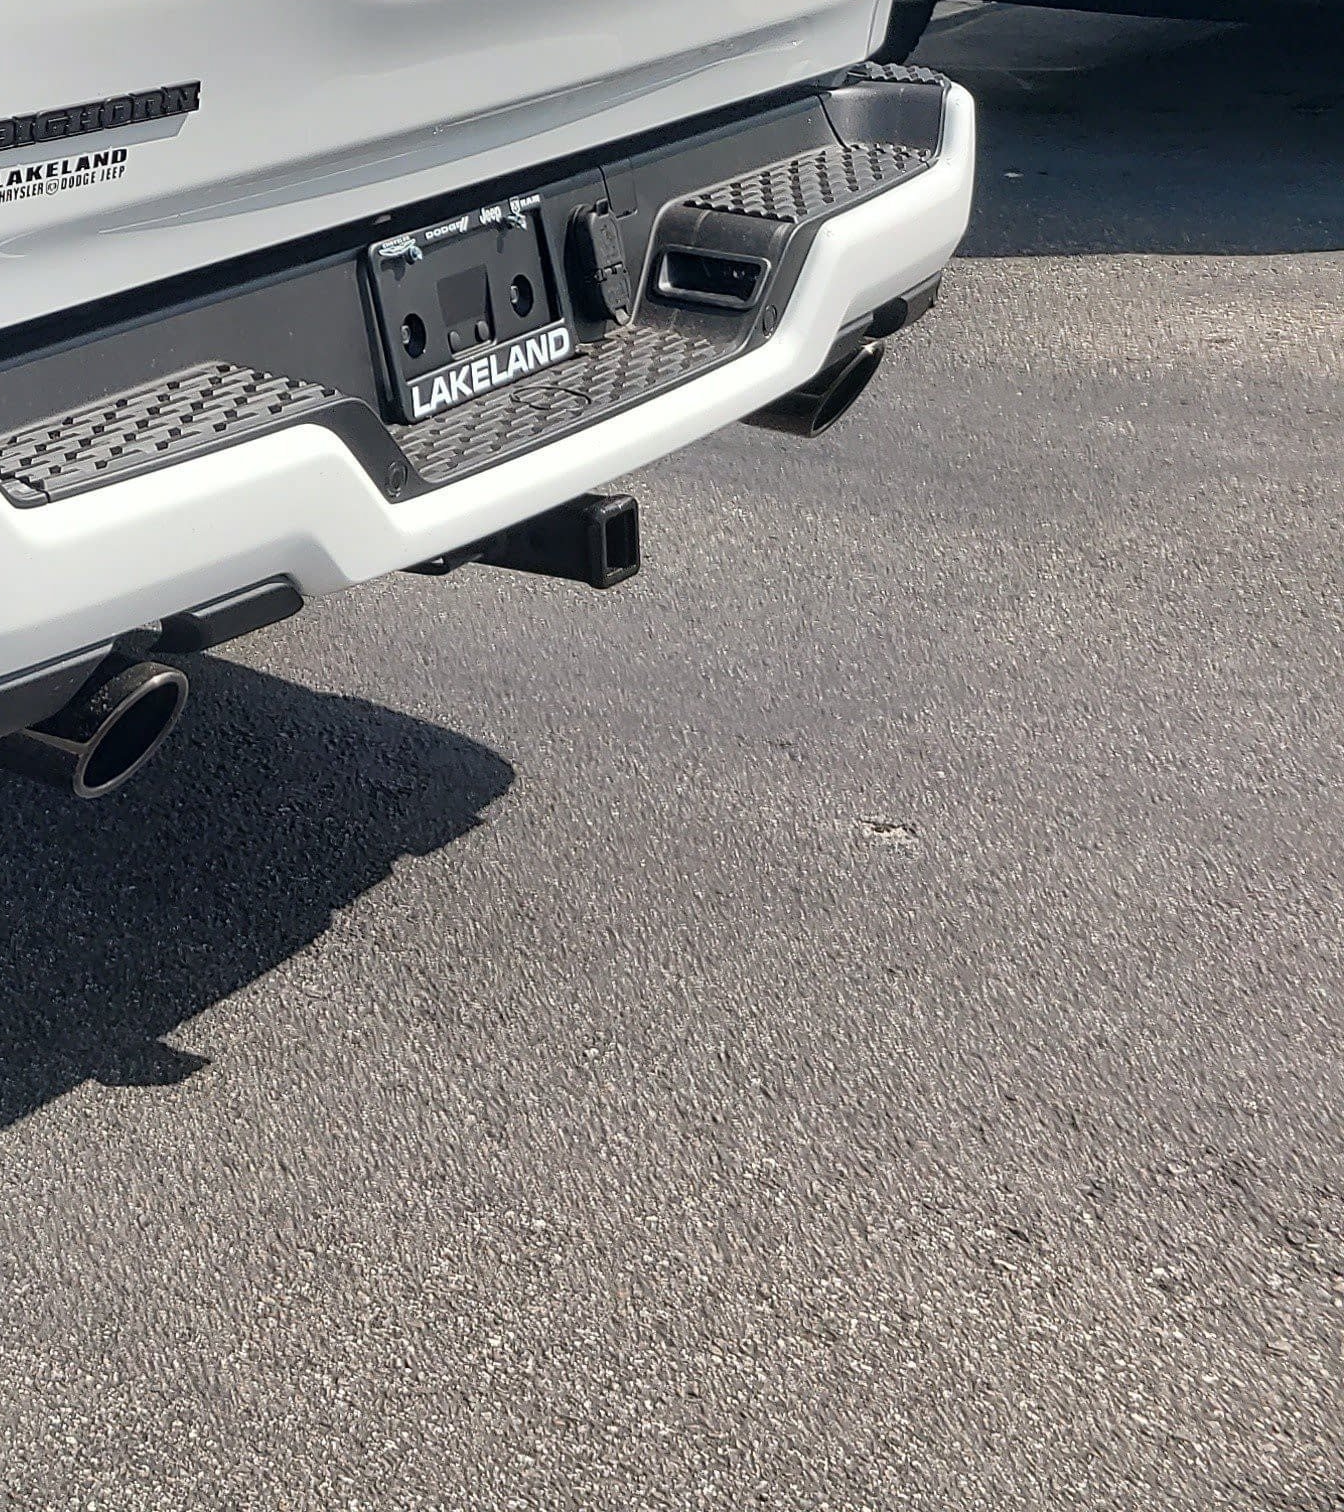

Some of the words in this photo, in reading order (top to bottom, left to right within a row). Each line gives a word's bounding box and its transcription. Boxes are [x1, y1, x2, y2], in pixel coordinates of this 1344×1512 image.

[61, 171, 96, 190] DODGE
[100, 165, 126, 182] JEEP
[479, 206, 502, 224] Jeep
[412, 326, 571, 419] LAKELAND
